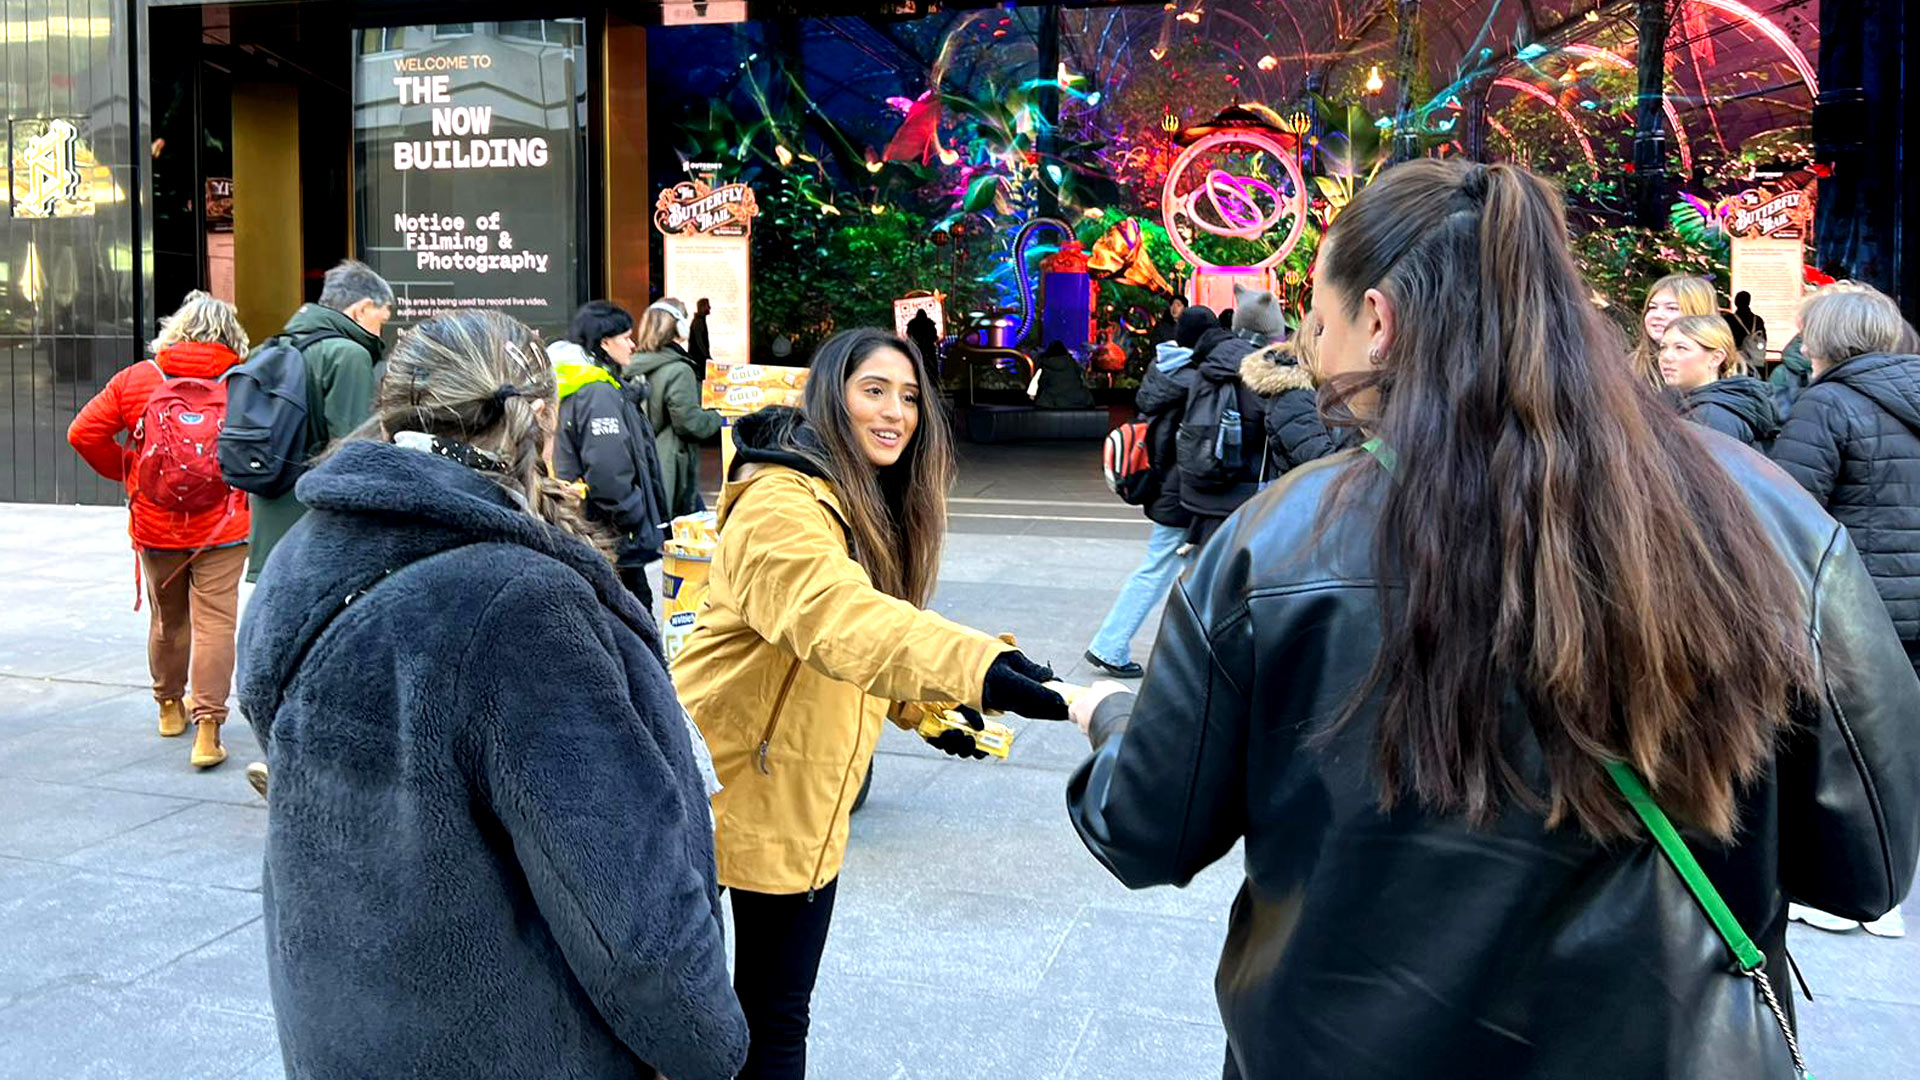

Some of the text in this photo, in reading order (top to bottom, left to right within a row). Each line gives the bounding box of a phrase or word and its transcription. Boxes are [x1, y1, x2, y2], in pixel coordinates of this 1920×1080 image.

[394, 55, 492, 72] WELCOME TO
[393, 75, 450, 104] THE
[432, 106, 492, 136] NOW
[393, 137, 548, 170] BUILDING
[668, 187, 744, 228] BUTTERFLY
[1736, 194, 1800, 231] BUTTERFLY
[394, 211, 501, 232] Notice of
[696, 208, 730, 231] TRAIL
[406, 230, 513, 253] Filming &
[417, 251, 548, 274] Photography
[437, 298, 457, 307] being
[458, 298, 476, 306] used
[486, 297, 511, 305] record
[512, 297, 525, 305] live
